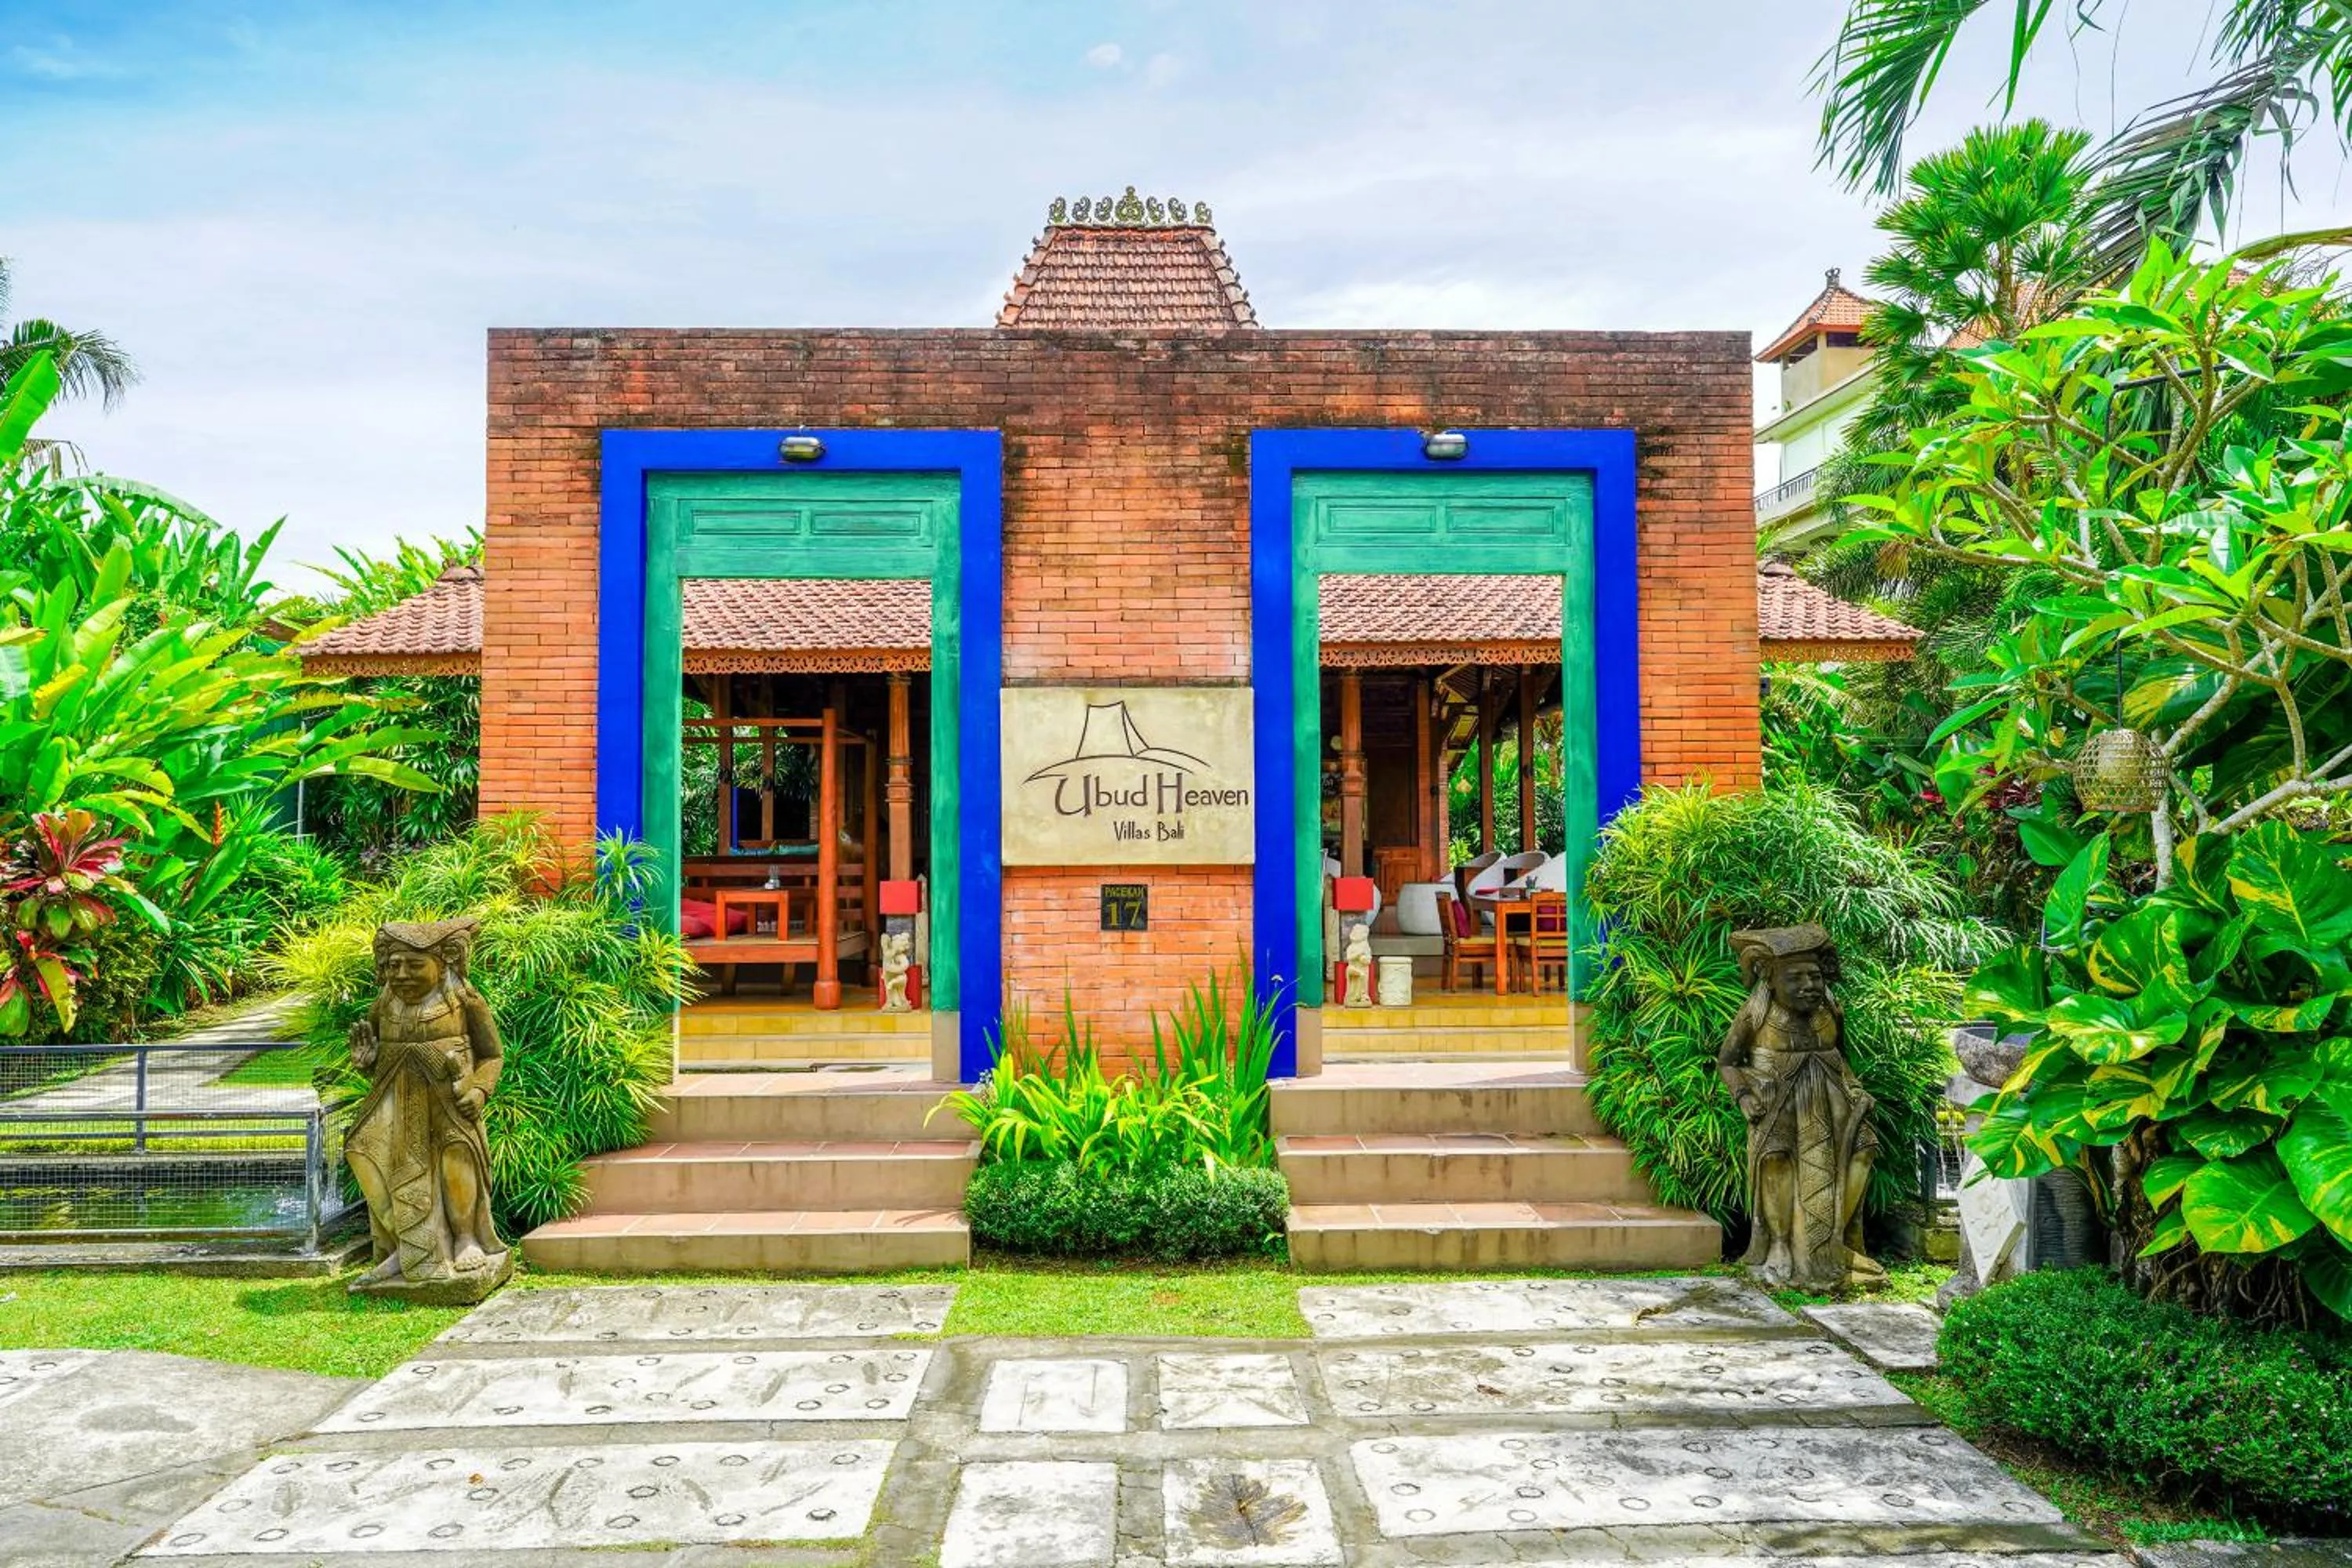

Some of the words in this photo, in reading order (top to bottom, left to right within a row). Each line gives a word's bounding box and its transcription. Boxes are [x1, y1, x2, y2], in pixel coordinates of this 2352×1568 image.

[1054, 773, 1148, 817] Ubud
[1156, 772, 1249, 815] Heaven
[1113, 821, 1151, 841] Villas
[1157, 821, 1185, 842] Bali
[1106, 901, 1142, 927] 17
